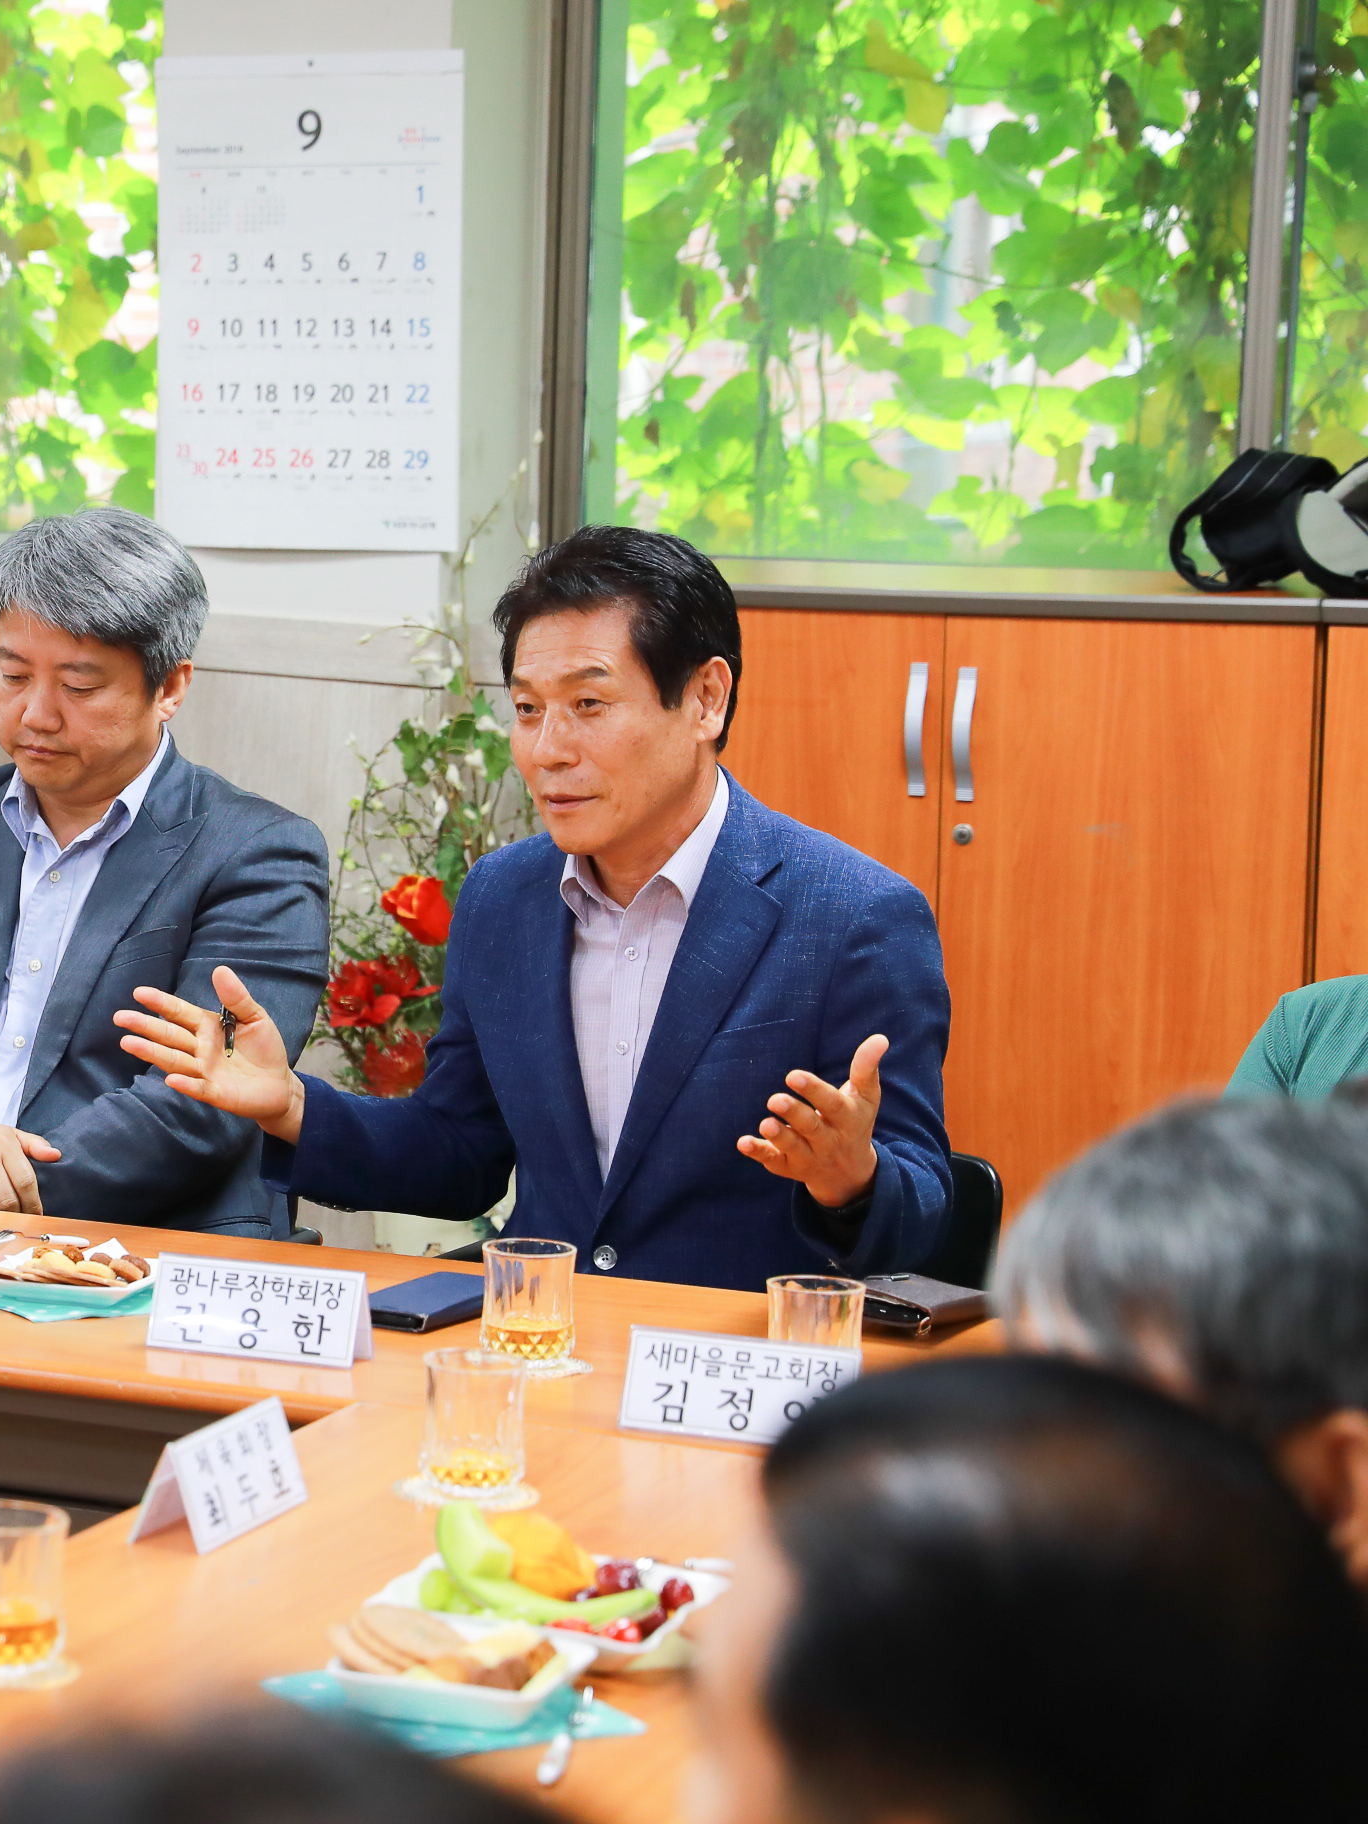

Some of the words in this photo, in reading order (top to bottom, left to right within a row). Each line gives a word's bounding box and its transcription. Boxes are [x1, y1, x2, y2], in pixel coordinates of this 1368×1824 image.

[296, 109, 323, 152] 9
[417, 185, 425, 204] 1
[190, 252, 203, 274] 2
[227, 252, 239, 273] 3
[263, 253, 276, 271] 4
[301, 251, 314, 273] 5
[337, 252, 351, 272] 6
[376, 251, 388, 272] 7
[412, 251, 427, 272] 8
[187, 318, 201, 337] 9
[220, 318, 244, 338] 10
[258, 318, 278, 337] 11
[295, 317, 318, 338] 12
[332, 317, 355, 338] 13
[370, 318, 392, 336] 14
[407, 317, 431, 338] 15
[181, 383, 203, 403] 16
[217, 382, 241, 402] 17
[255, 383, 278, 403] 18
[293, 383, 316, 402] 19
[330, 383, 355, 404] 20
[367, 383, 389, 404] 21
[405, 383, 430, 404] 22
[216, 448, 239, 467] 24
[251, 447, 277, 468] 25
[289, 448, 314, 468] 26
[327, 448, 352, 469] 27
[365, 449, 391, 470] 28
[403, 449, 430, 470] 29
[169, 1267, 346, 1311] 광나루장학회장
[644, 1341, 843, 1394] 새마을문고회장
